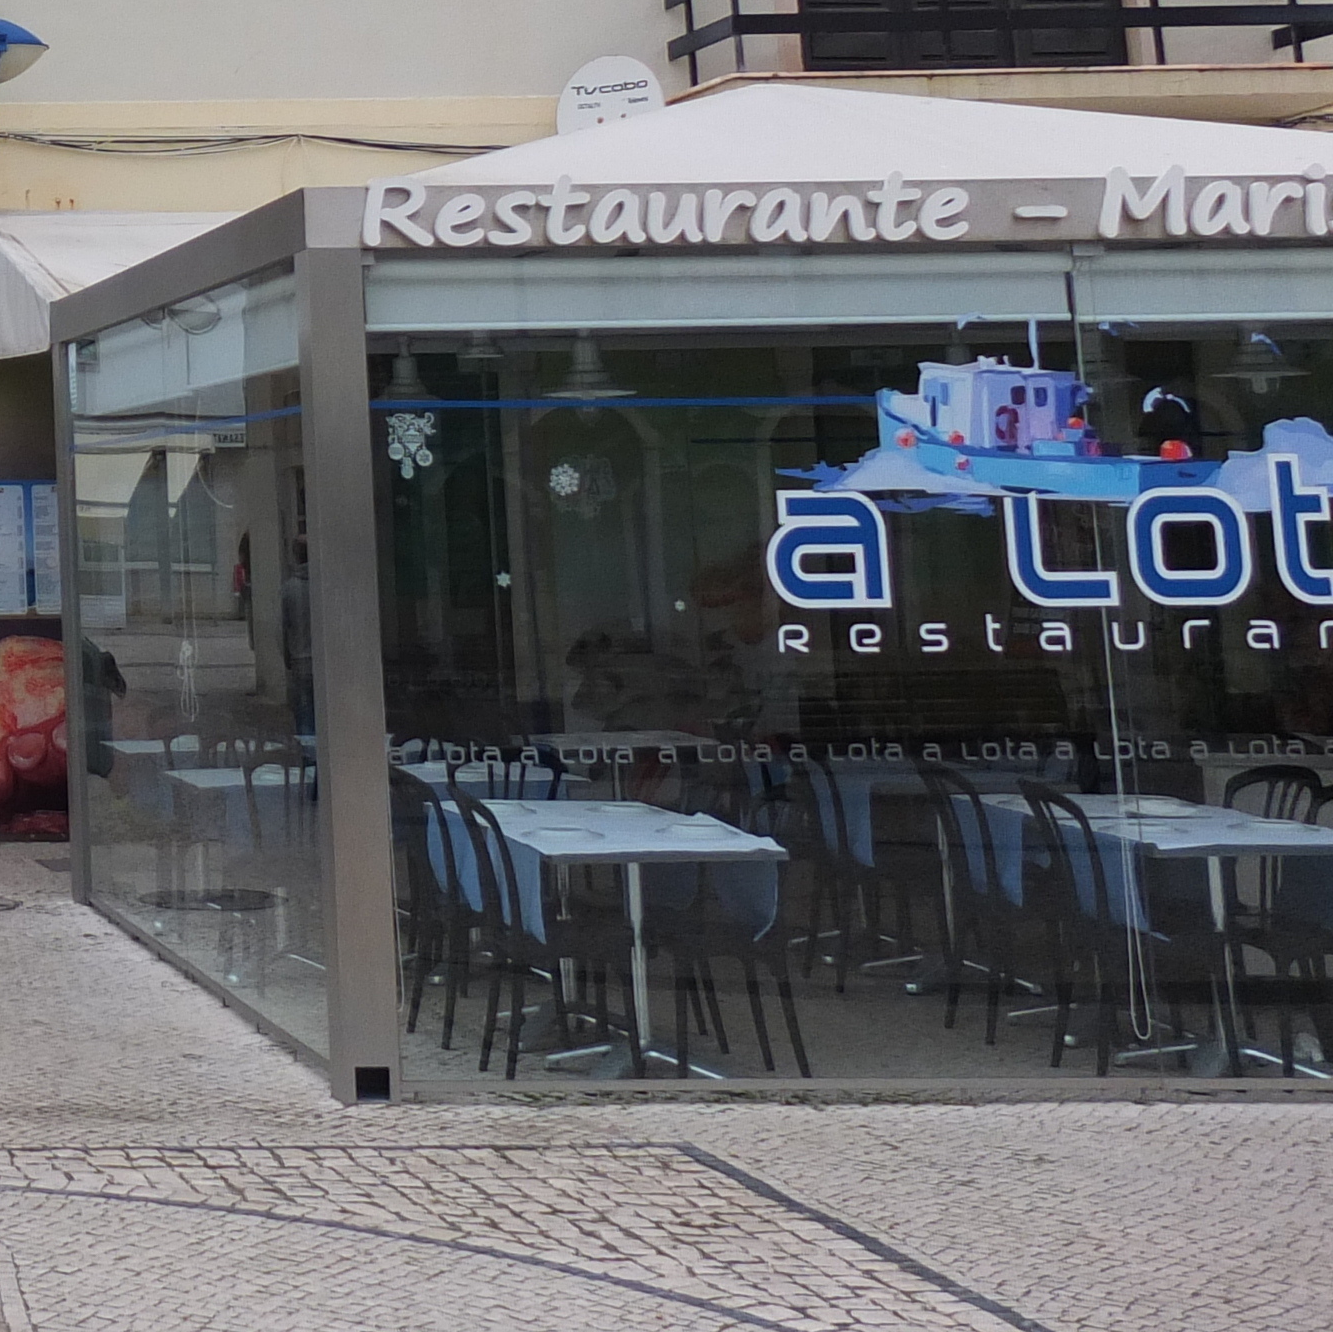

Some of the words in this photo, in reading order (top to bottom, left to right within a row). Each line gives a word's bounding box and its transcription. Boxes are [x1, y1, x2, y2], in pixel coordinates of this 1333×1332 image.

[361, 173, 972, 248] Restaurante
[1098, 164, 1333, 239] Mari
[767, 490, 892, 608] a
